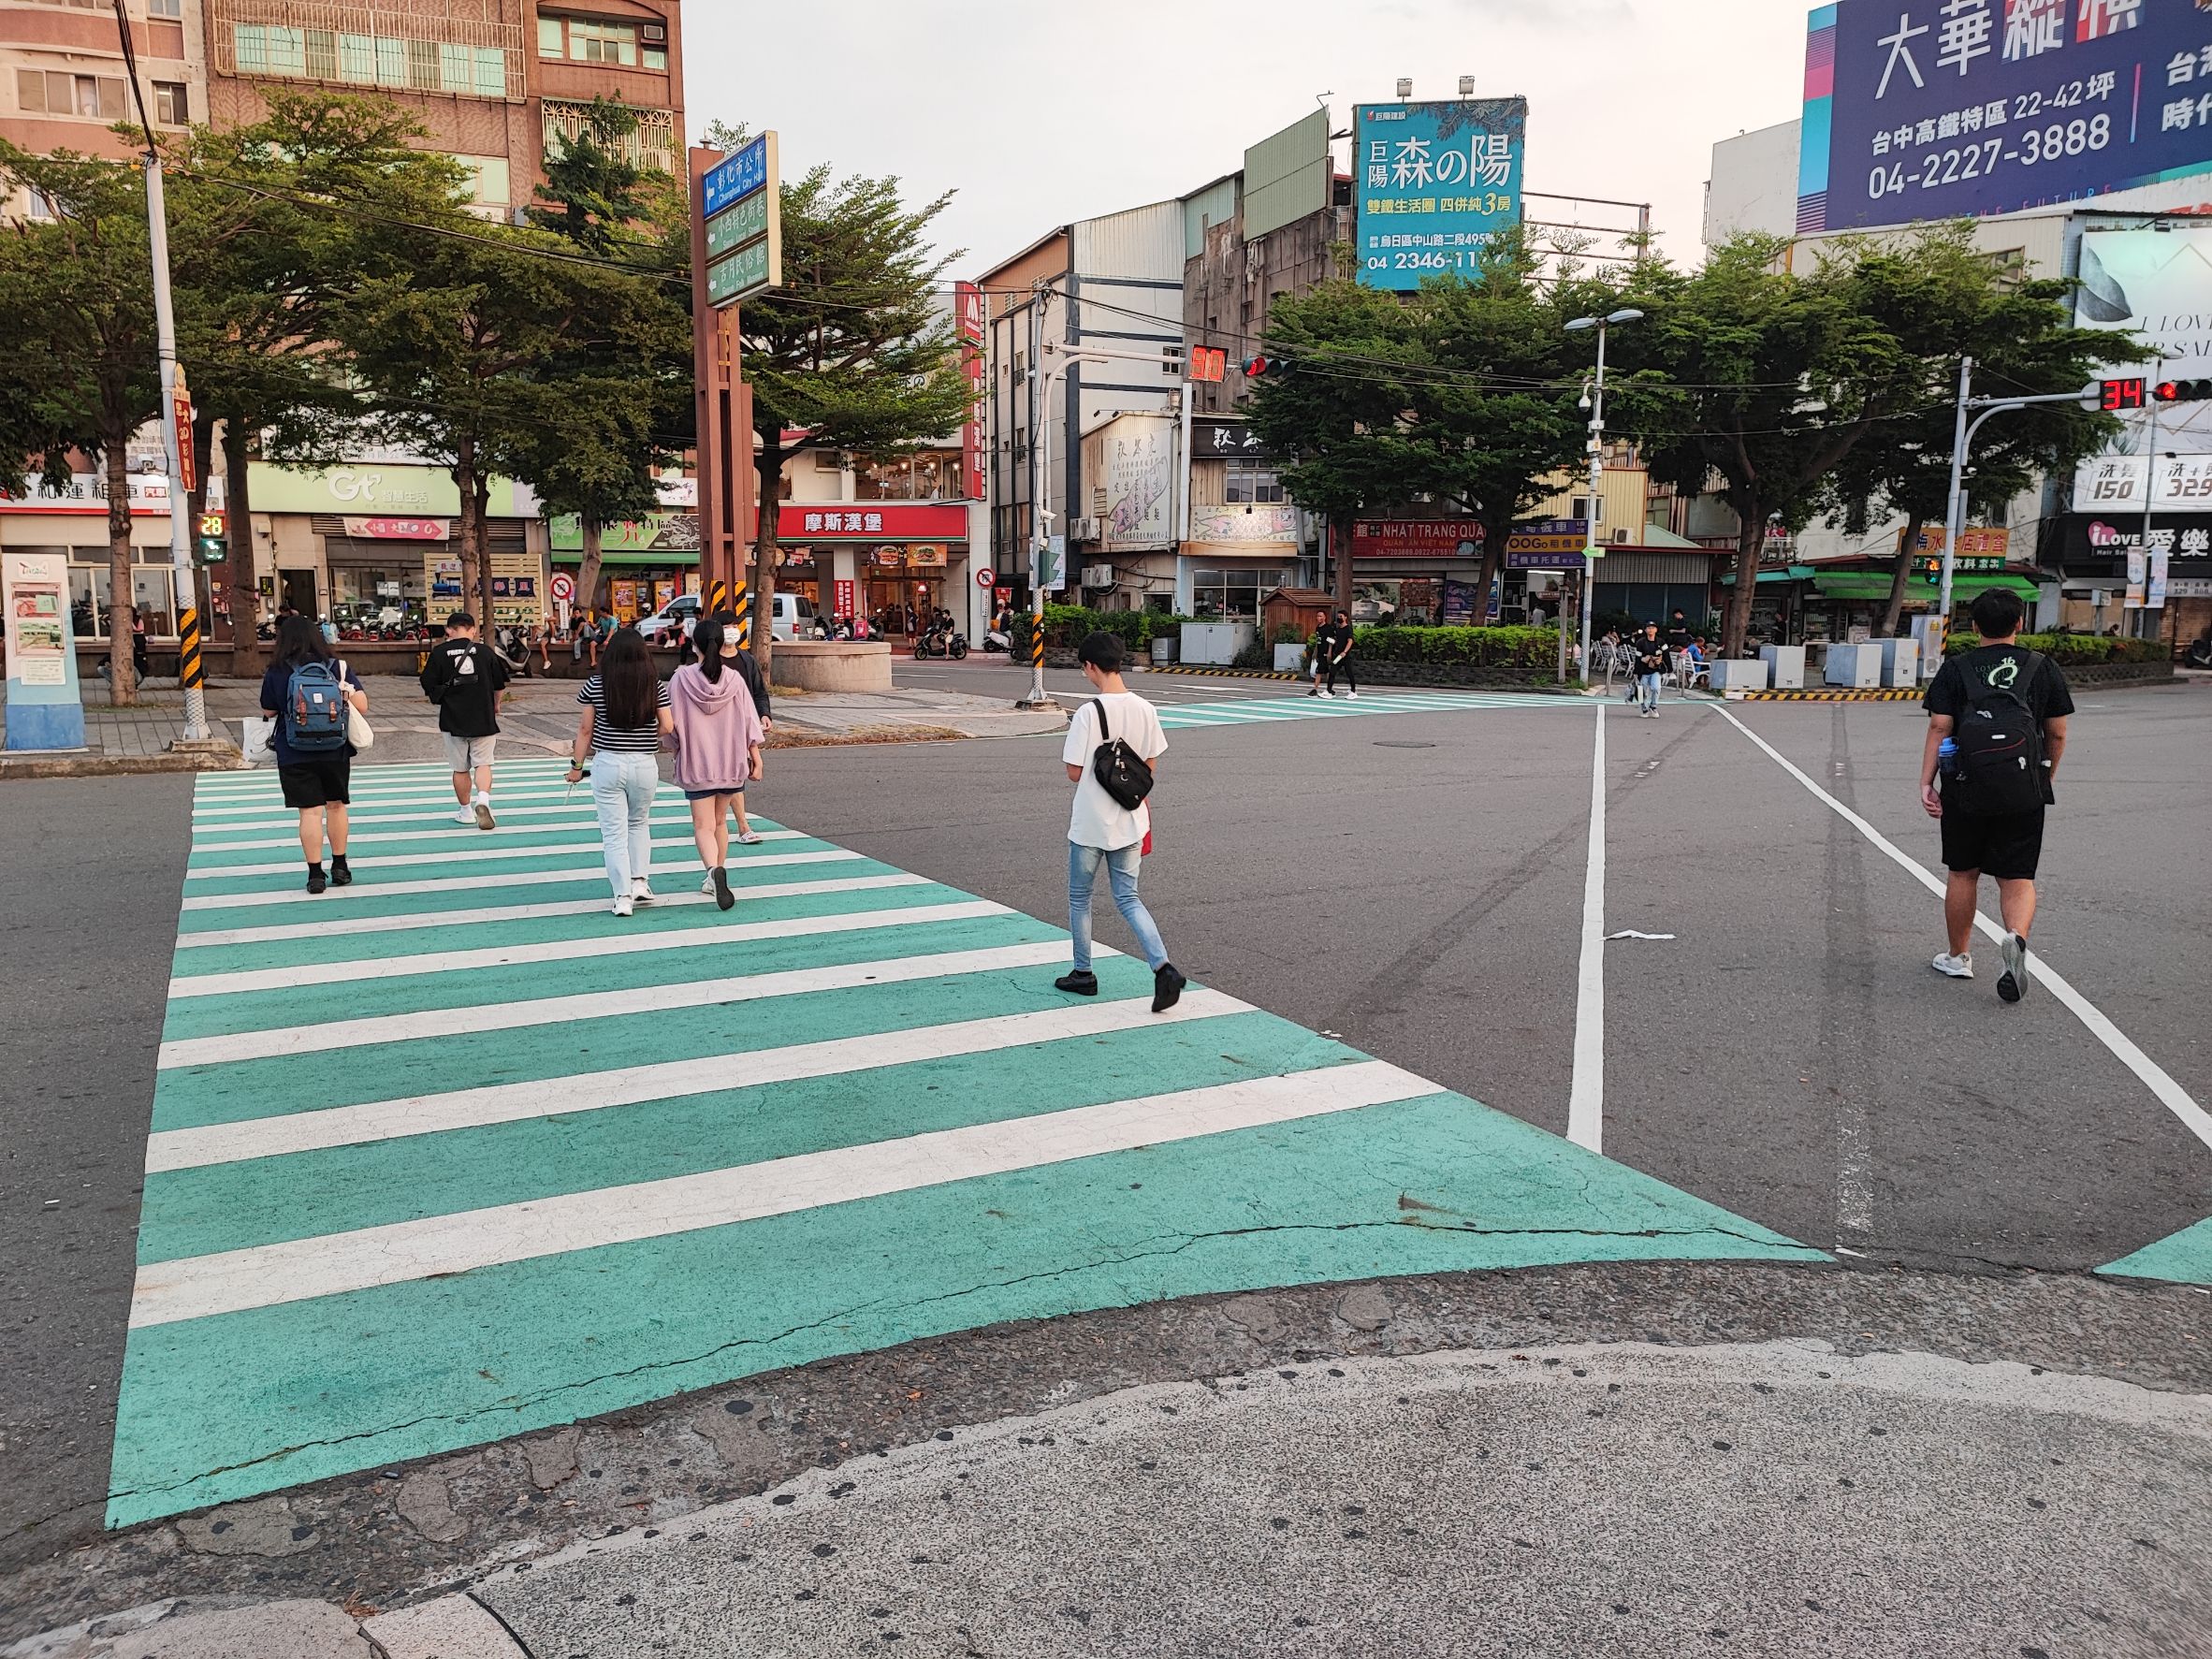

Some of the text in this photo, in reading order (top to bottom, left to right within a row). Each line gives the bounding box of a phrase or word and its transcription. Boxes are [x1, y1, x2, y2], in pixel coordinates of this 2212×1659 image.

[1871, 70, 2116, 157] 台中高鐵特區 22-42坪
[1390, 134, 1513, 190] 森の陽
[1868, 113, 2111, 200] 04-2227-3888
[718, 143, 764, 192] 彰化市公所
[1367, 251, 1505, 270] 04 2346-11
[2103, 379, 2141, 410] 34
[2093, 480, 2134, 500] 150
[2166, 478, 2212, 497] 329
[201, 516, 223, 535] 28
[805, 513, 882, 532] 摩斯漢堡
[1418, 524, 1456, 538] TRANG
